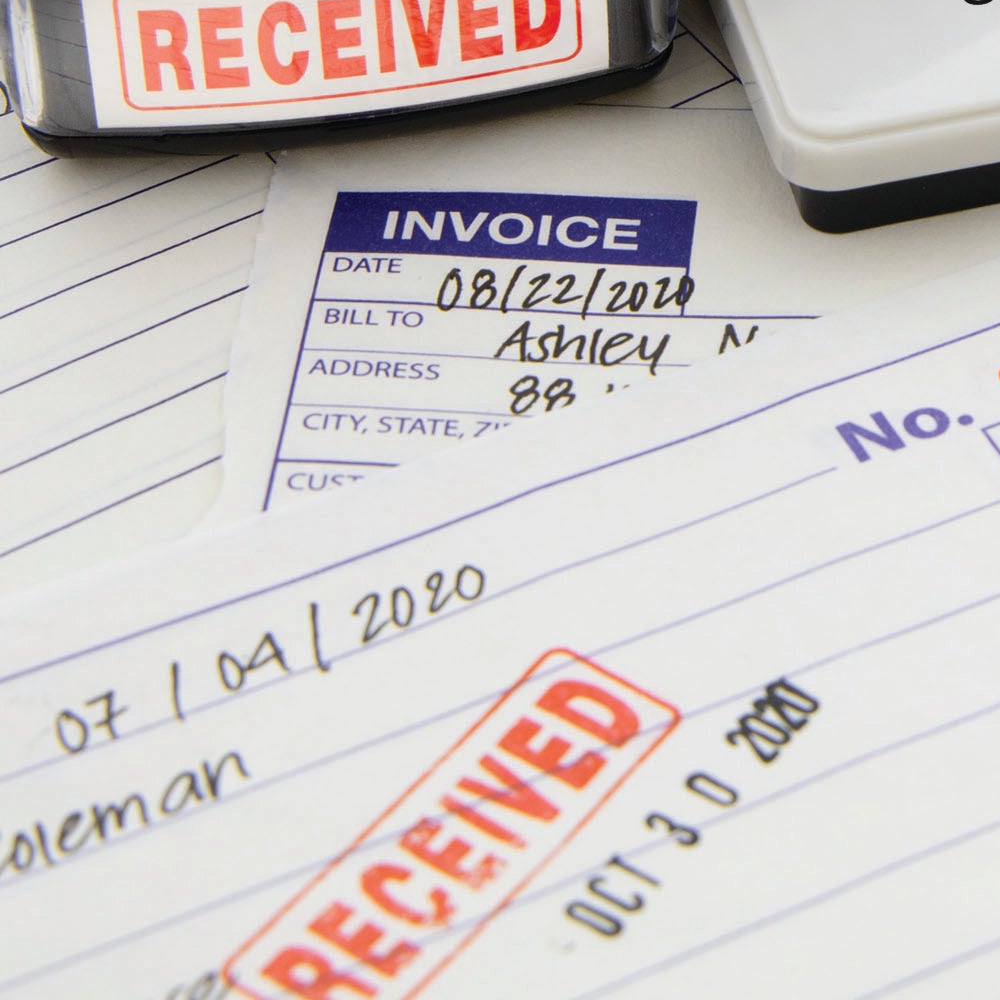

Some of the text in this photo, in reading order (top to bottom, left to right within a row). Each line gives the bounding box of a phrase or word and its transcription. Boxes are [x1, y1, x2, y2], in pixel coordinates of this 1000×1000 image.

[382, 209, 642, 252] INVOICE
[332, 256, 404, 275] DATE
[436, 264, 696, 321] 08/22/2020
[323, 307, 425, 329] BILL TO
[308, 359, 441, 381] ADDRESS
[493, 319, 672, 377] Ashley
[302, 412, 370, 437] CITY,
[377, 416, 466, 441] STATE,
[836, 405, 976, 464] No.
[564, 853, 663, 939] OCT
[724, 675, 821, 766] 2020
[259, 678, 641, 1000] RECEIVED
